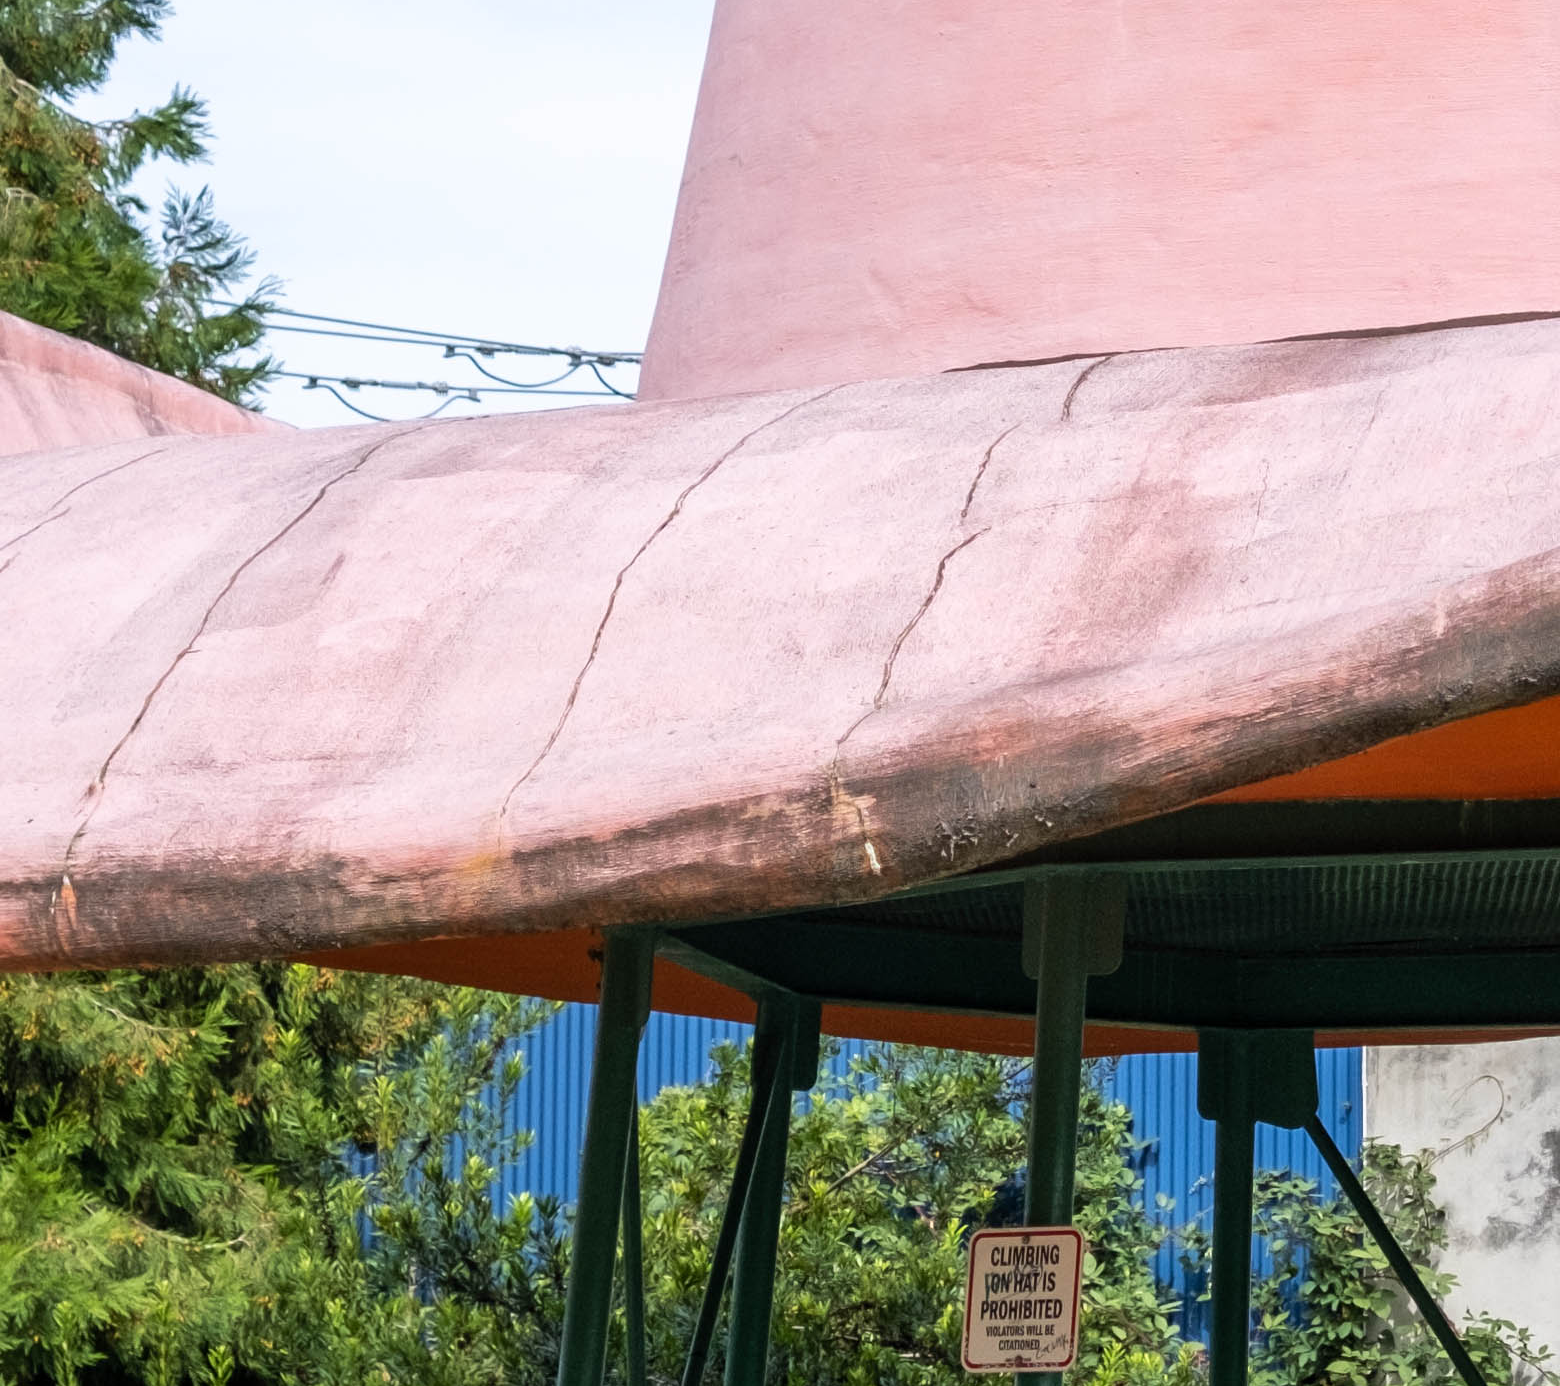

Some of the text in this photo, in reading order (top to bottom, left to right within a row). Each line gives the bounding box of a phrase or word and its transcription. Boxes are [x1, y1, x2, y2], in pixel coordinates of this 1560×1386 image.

[991, 1245, 1060, 1267] CLIMBING
[991, 1271, 1056, 1294] ON HAT IS
[981, 1299, 1062, 1320] PROHIBITED
[986, 1324, 1055, 1337] VIOLATORS WILL BE
[998, 1339, 1040, 1351] CITATIONED
